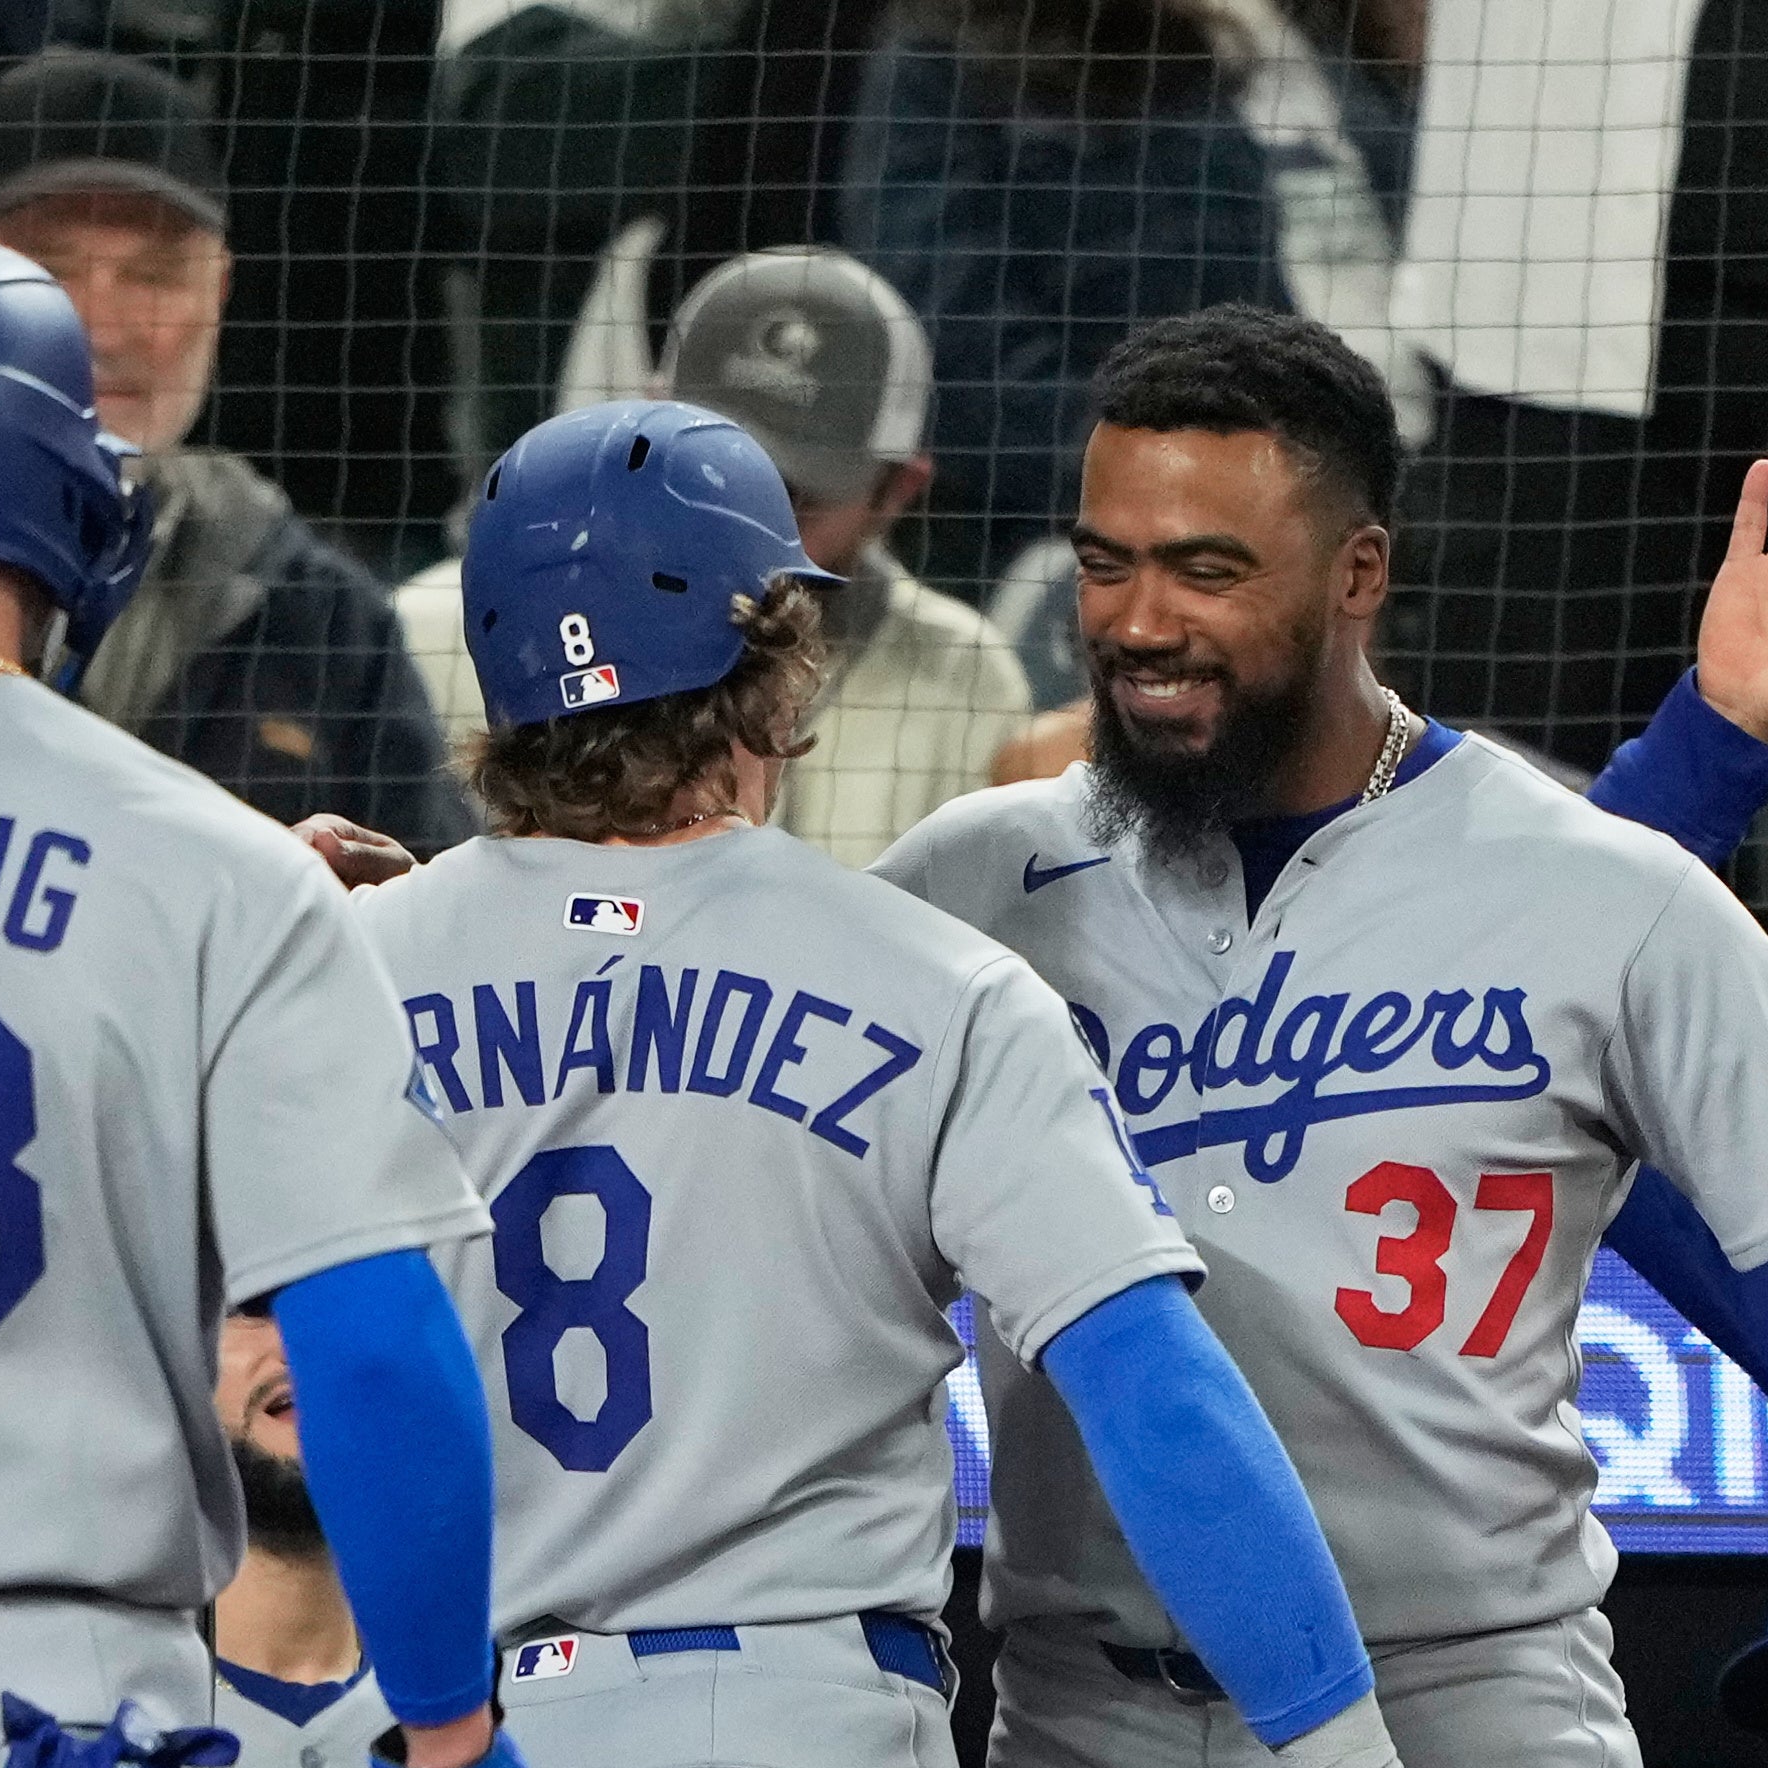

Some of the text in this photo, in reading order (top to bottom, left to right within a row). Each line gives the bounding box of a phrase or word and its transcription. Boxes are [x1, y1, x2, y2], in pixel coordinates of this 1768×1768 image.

[557, 612, 596, 668] 8
[401, 955, 924, 1161] RNÁNDEZ
[489, 1144, 653, 1473] 8
[1334, 1160, 1555, 1359] 37
